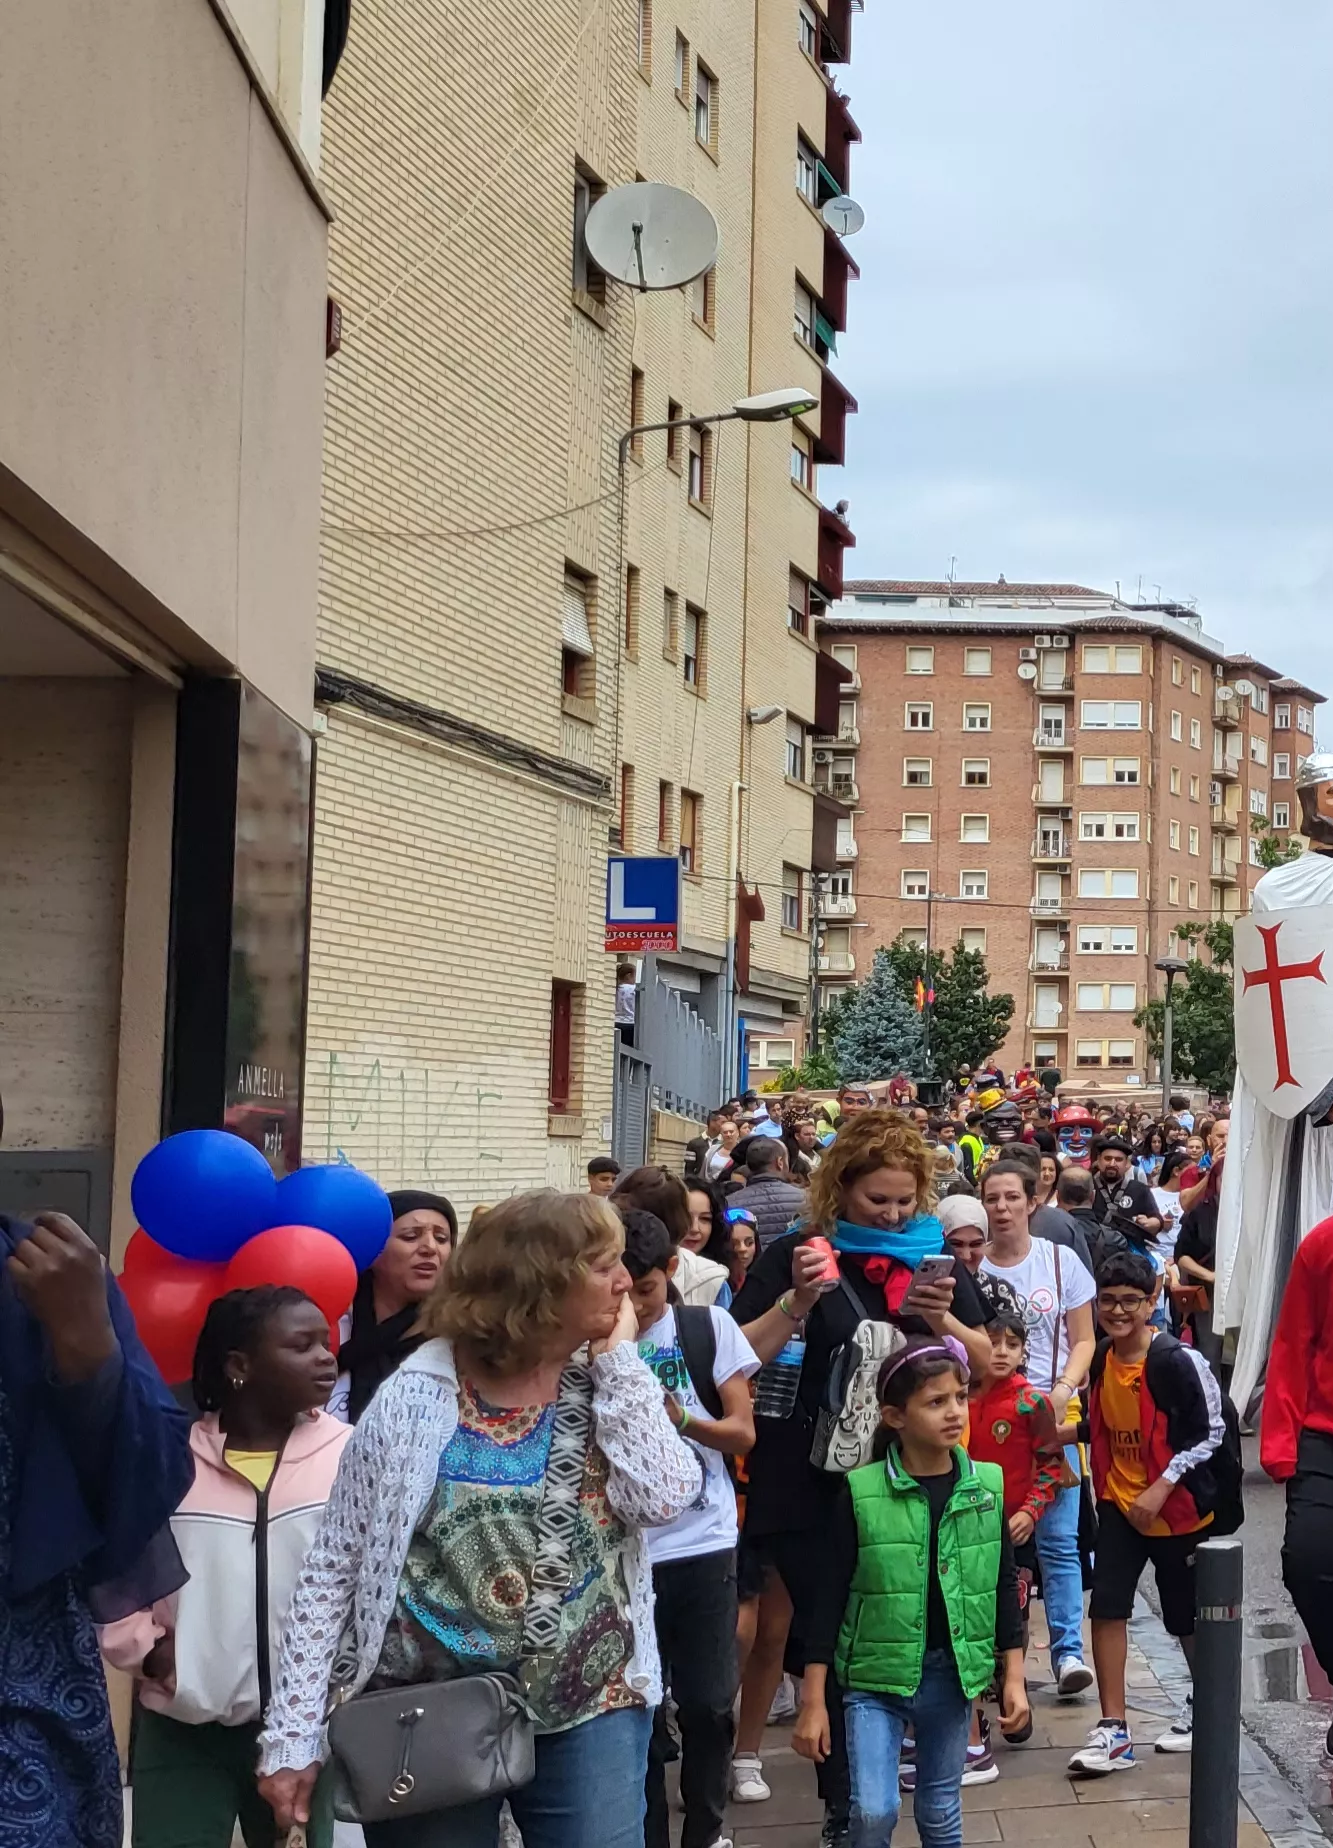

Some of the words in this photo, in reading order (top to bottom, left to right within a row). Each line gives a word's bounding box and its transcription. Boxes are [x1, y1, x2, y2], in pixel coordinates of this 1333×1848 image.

[610, 861, 656, 920] L
[605, 931, 673, 939] UTOESCUELA
[238, 1063, 284, 1099] ANMELLA
